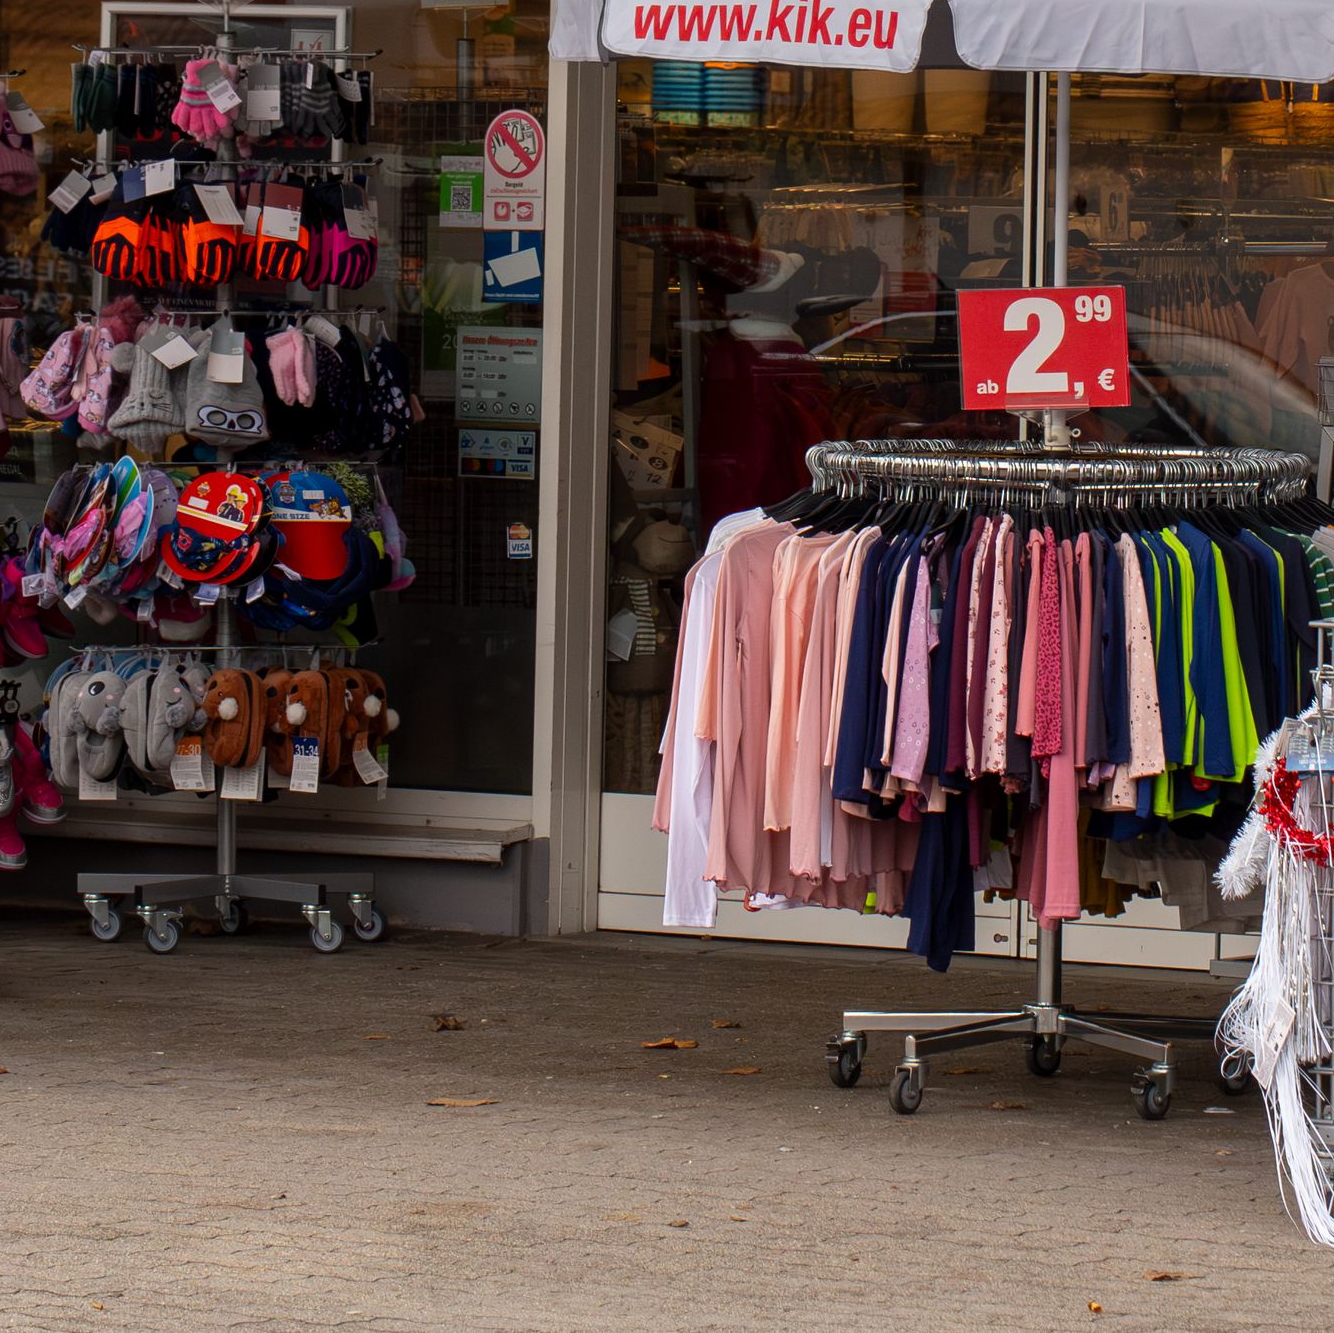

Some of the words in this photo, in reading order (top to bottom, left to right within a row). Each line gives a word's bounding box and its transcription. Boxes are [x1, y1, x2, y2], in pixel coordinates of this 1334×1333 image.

[975, 378, 1000, 396] ab
[1096, 368, 1116, 392] €
[511, 464, 528, 472] VISA
[512, 542, 530, 552] VISA
